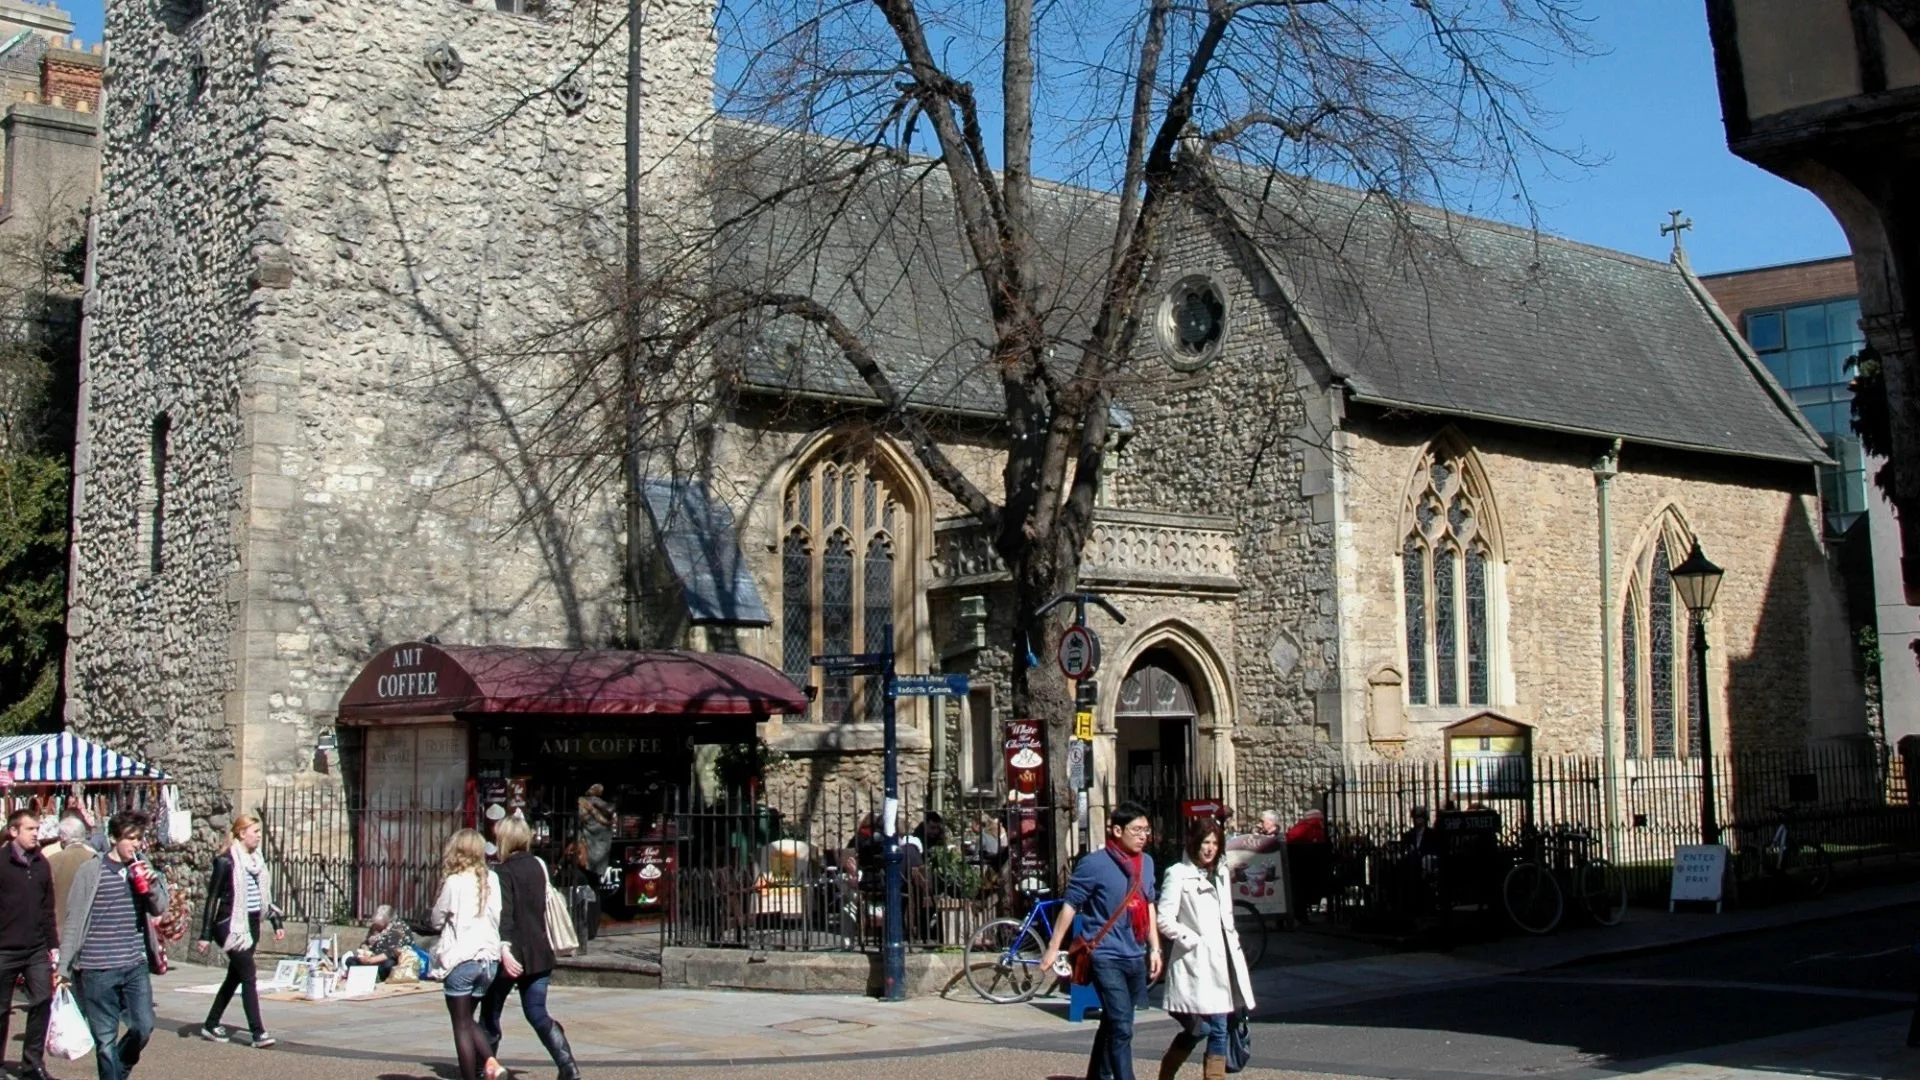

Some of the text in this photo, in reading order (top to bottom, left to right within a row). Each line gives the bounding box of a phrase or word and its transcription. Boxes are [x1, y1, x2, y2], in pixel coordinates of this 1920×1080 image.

[393, 648, 424, 668] AMT
[378, 672, 437, 697] COFFEE
[1012, 724, 1038, 734] White
[1079, 716, 1092, 736] H
[540, 739, 662, 753] AMT COFFEE
[1465, 816, 1494, 829] STREET
[1683, 853, 1716, 861] ENTER
[600, 866, 622, 884] MT
